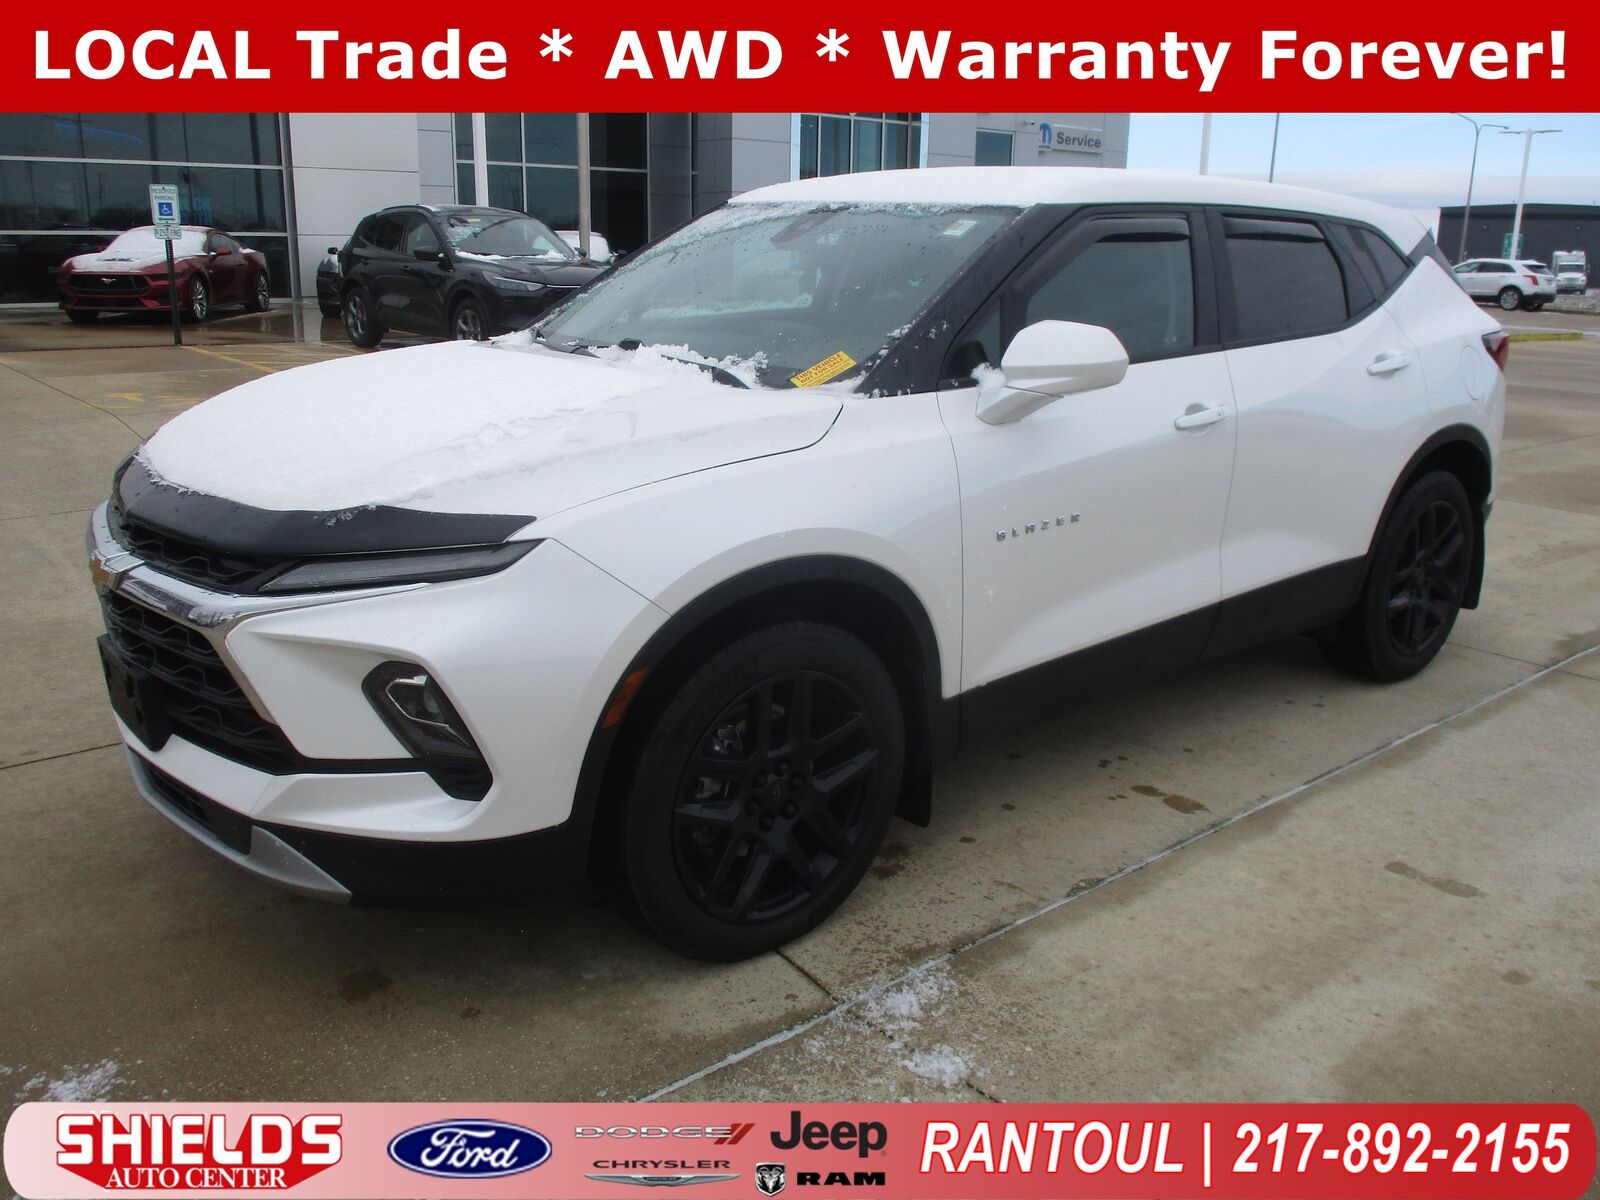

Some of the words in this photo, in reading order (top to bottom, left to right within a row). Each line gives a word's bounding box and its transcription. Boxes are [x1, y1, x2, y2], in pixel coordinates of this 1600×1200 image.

[1056, 131, 1101, 148] Service
[796, 369, 812, 381] THIS
[812, 353, 842, 371] VEHICLE
[996, 512, 1080, 542] BLAZER
